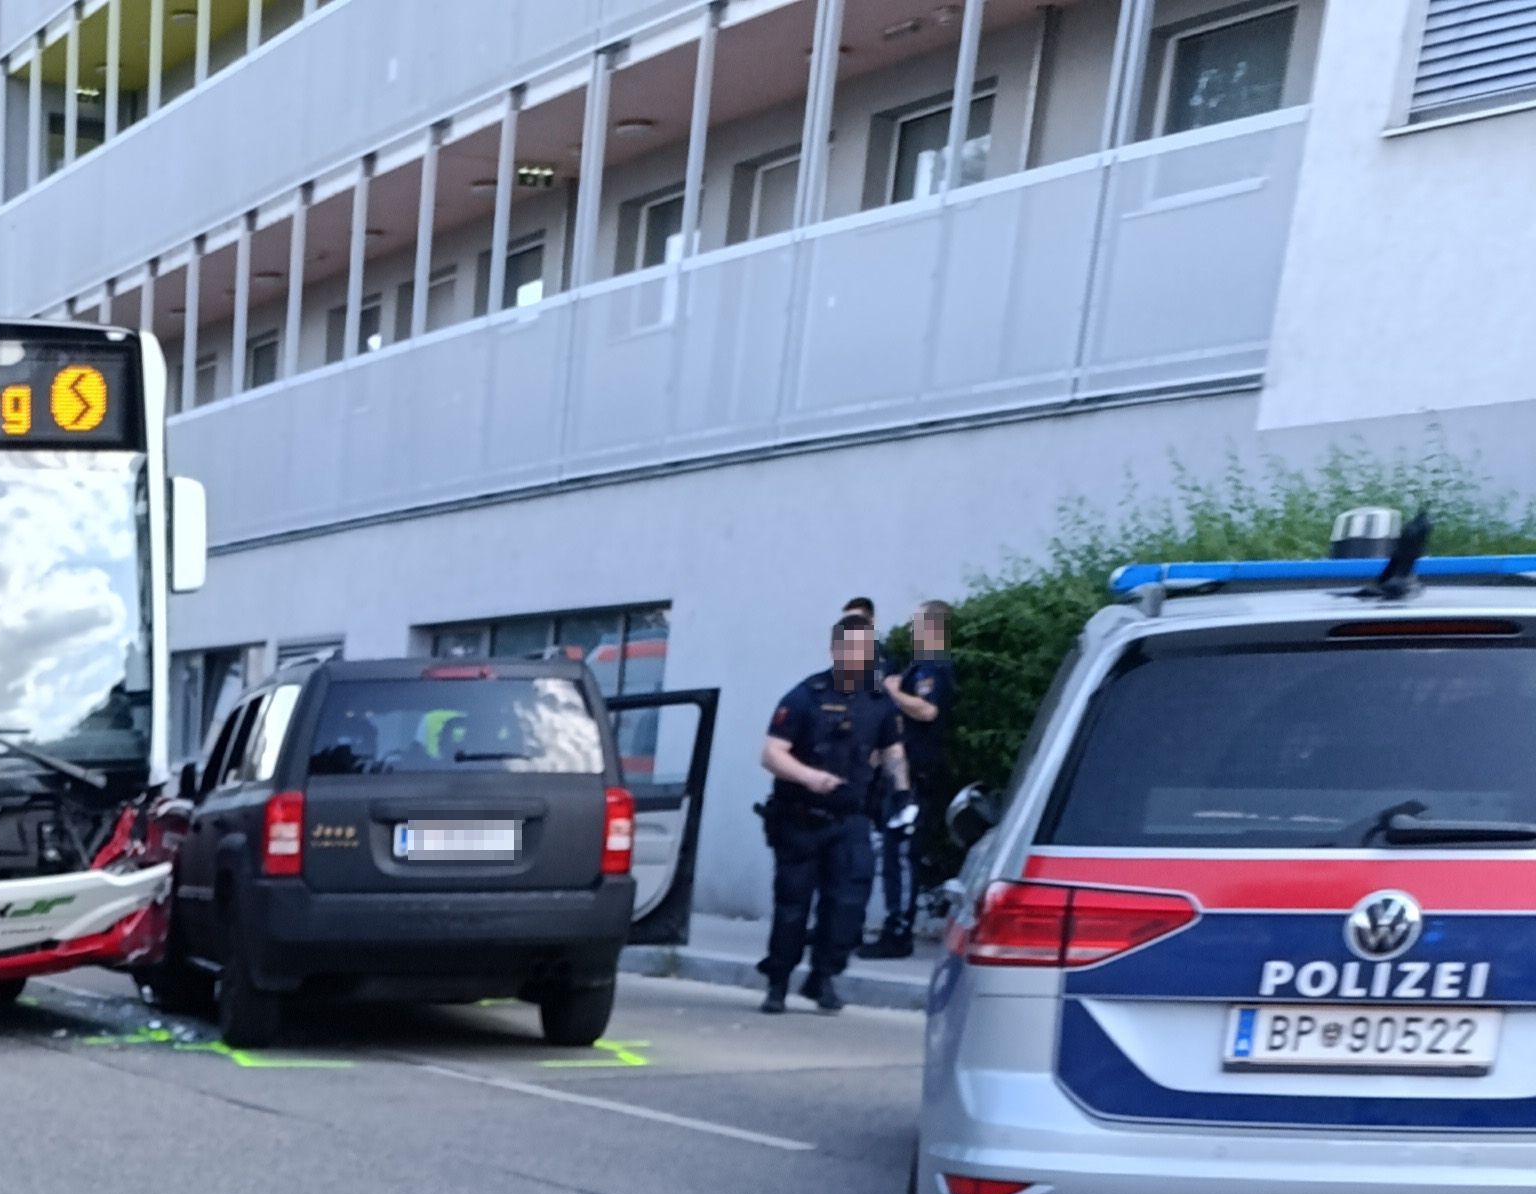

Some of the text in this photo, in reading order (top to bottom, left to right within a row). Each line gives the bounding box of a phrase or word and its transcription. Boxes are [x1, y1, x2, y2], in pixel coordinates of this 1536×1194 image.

[1258, 960, 1491, 998] POLIZEI
[1267, 1015, 1478, 1055] BP 90522
